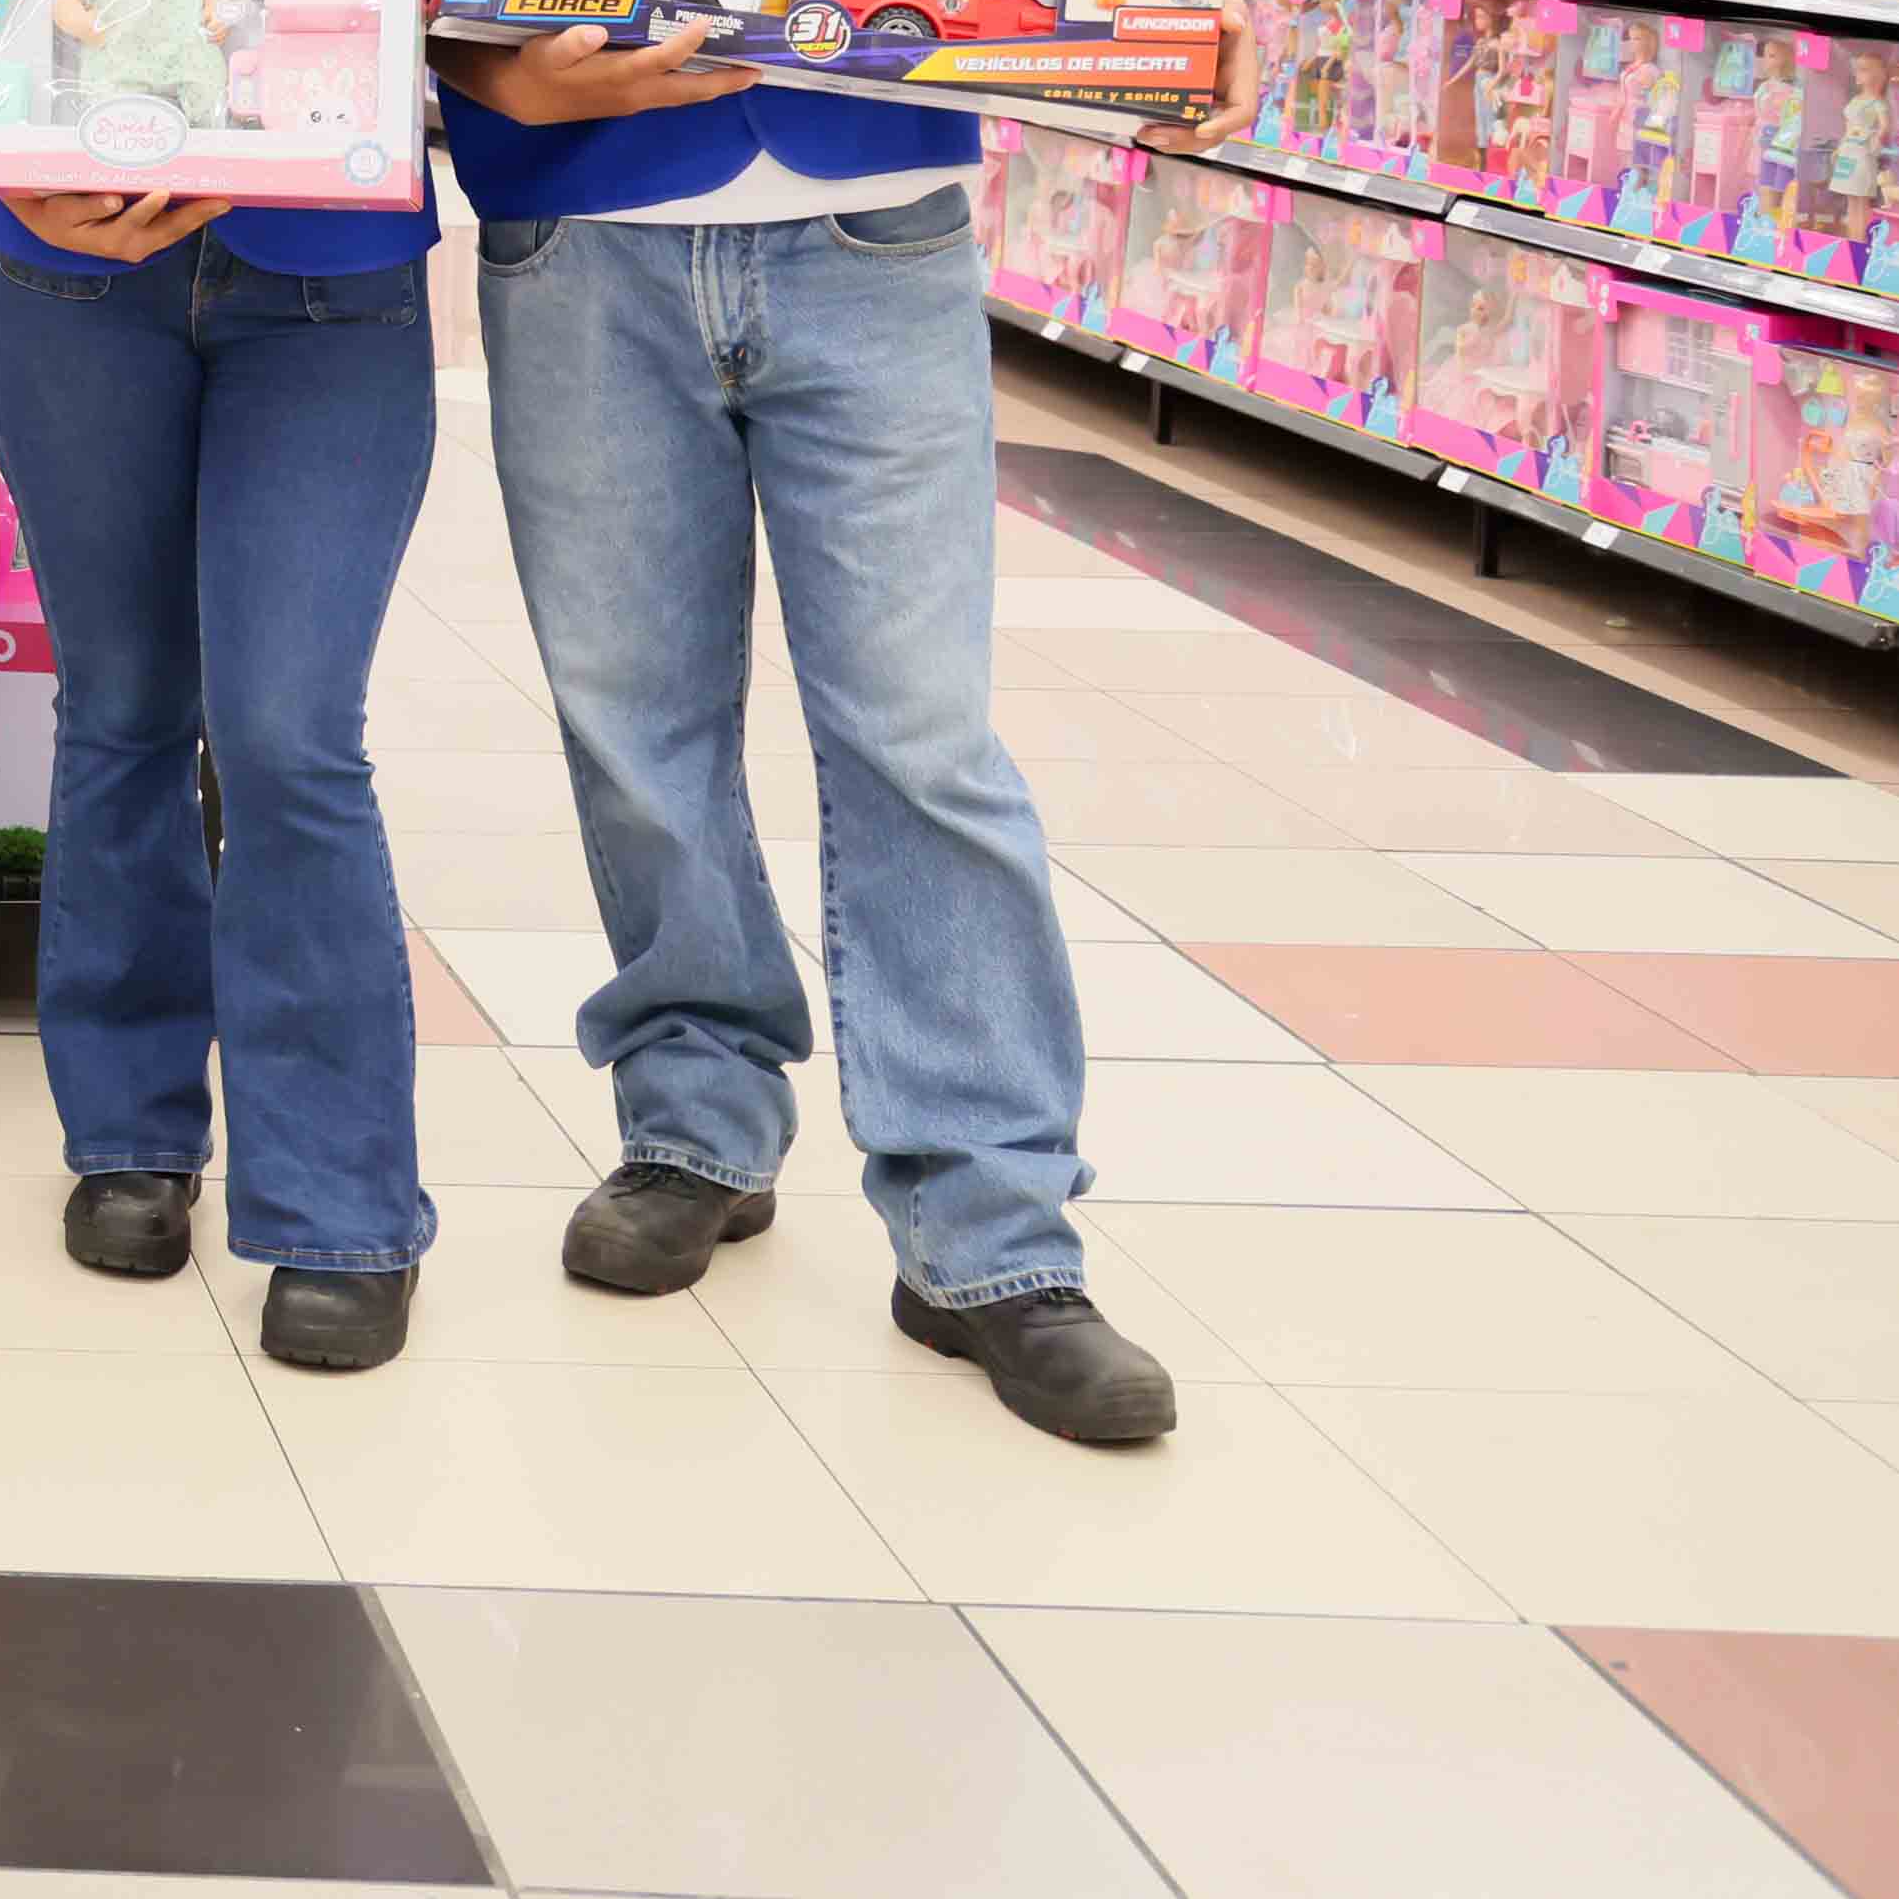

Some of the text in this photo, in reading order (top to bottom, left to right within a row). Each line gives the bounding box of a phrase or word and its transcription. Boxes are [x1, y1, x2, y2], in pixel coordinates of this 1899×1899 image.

[791, 12, 843, 42] 31
[1121, 15, 1215, 32] LANZADOR
[1067, 56, 1094, 73] DE
[1098, 56, 1189, 72] RESCATE
[1043, 88, 1181, 103] con luz y sonido
